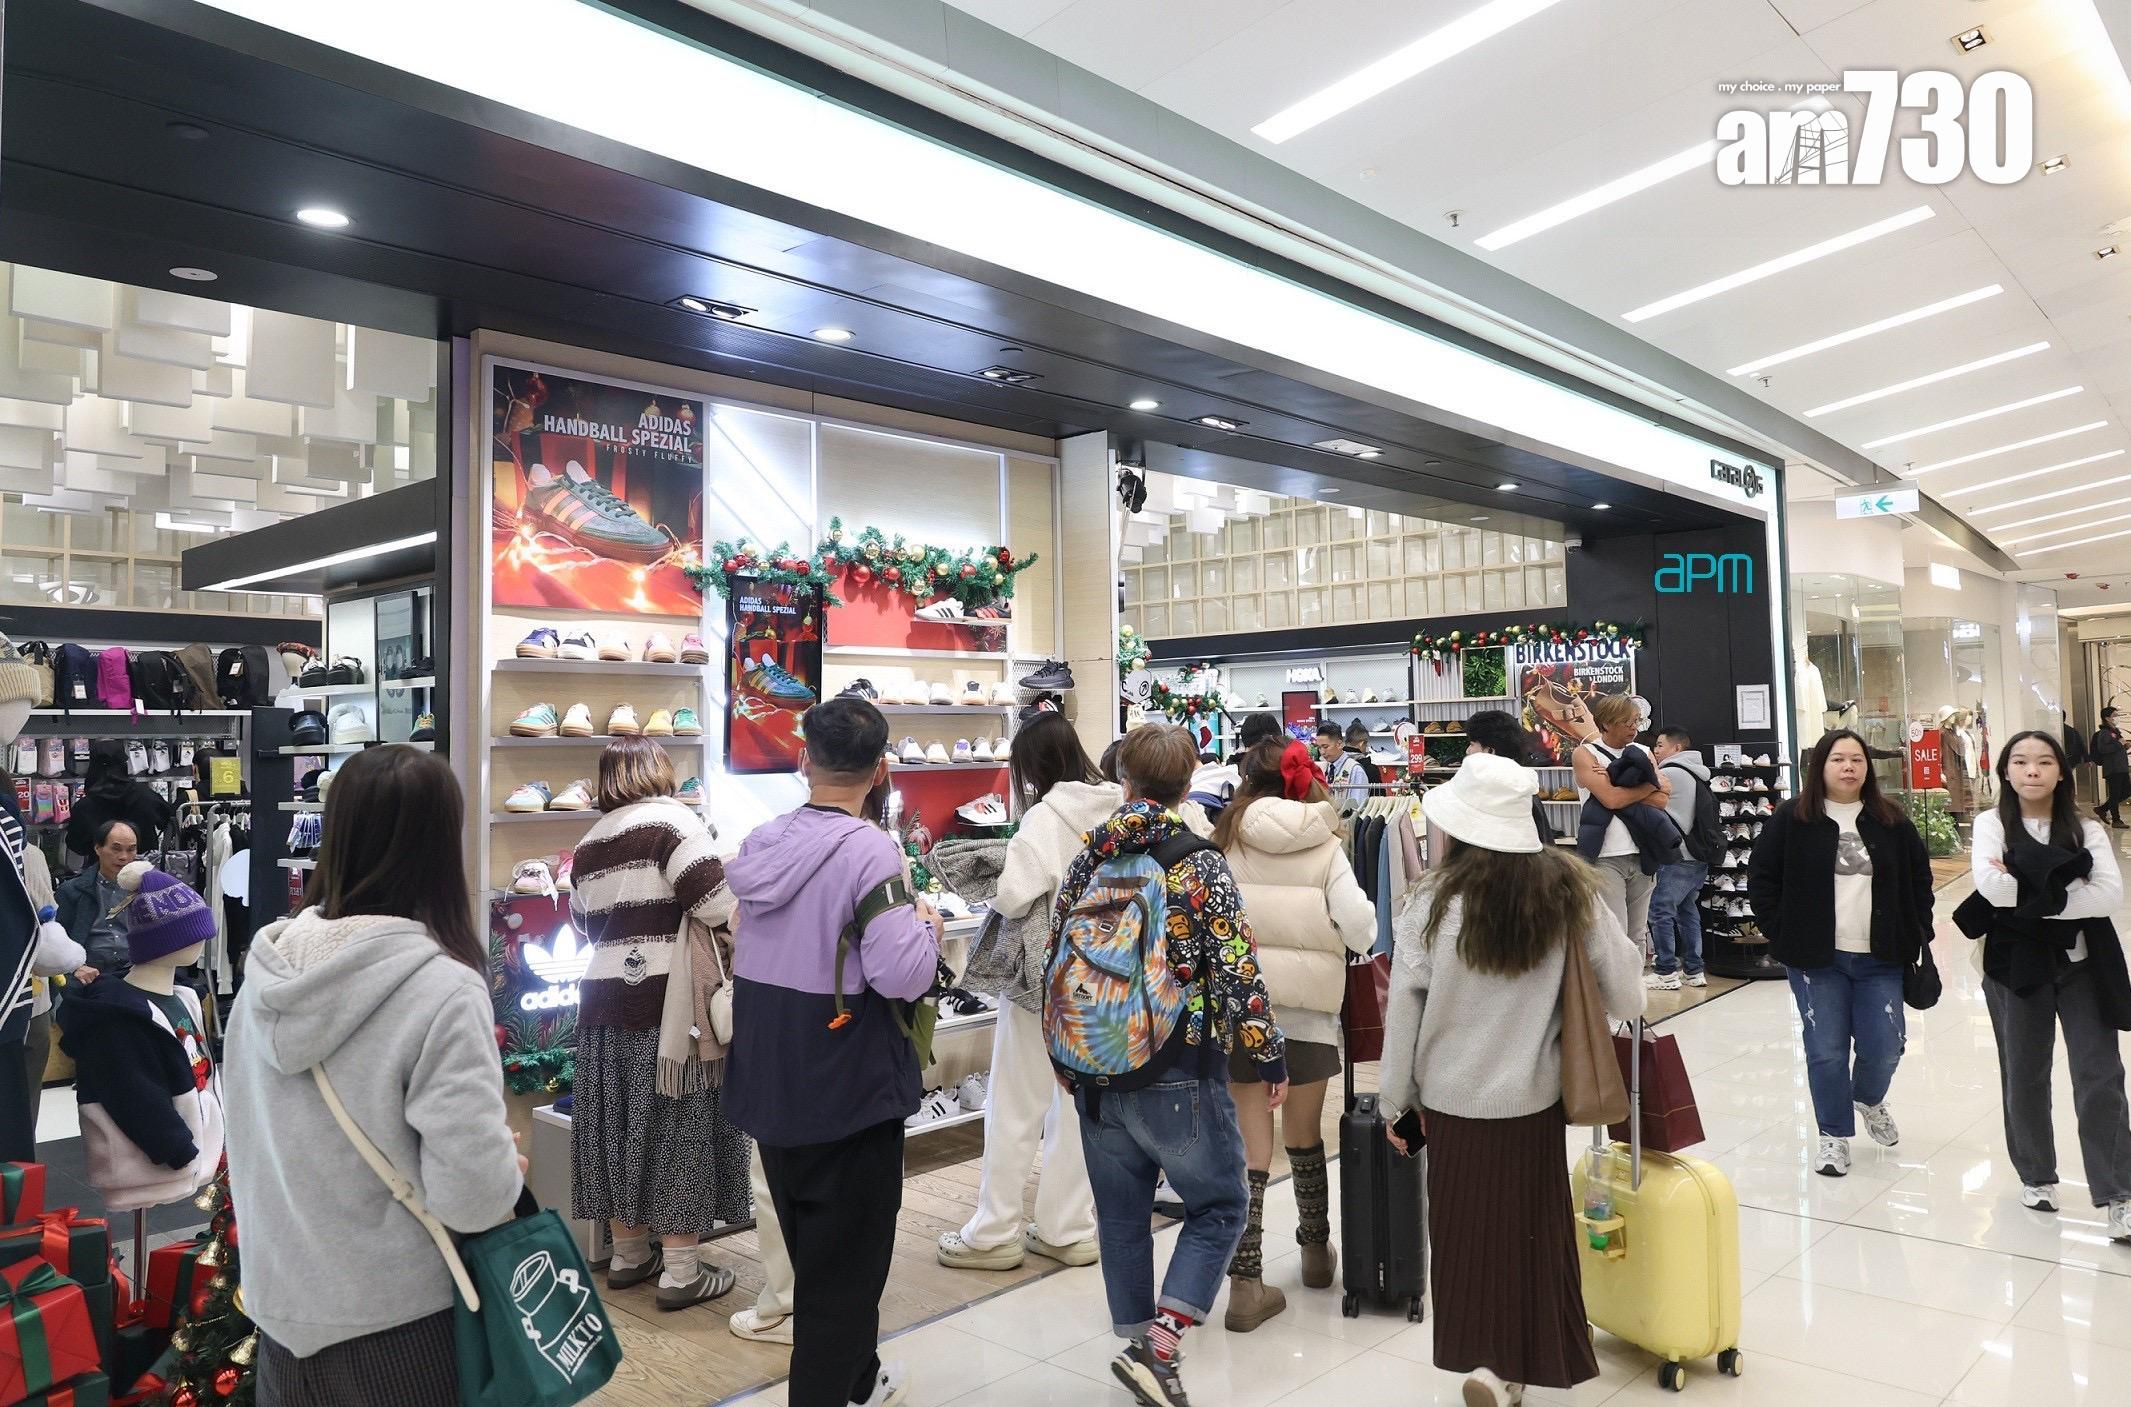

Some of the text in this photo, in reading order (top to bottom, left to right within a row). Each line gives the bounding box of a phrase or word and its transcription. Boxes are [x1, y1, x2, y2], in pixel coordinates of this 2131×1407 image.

[638, 413, 692, 436] ADIDAS
[544, 415, 692, 453] HANDBALL SPEZIAL
[606, 444, 693, 464] FROSTY FLUFFY
[740, 596, 762, 605] ADIDAS
[740, 604, 796, 614] HANDBALL SPEZIAL
[1516, 637, 1631, 664] BIRKENSTOCK
[1574, 665, 1624, 677] BIRKENSTOCK
[1593, 674, 1624, 684] LONDON
[1410, 753, 1423, 764] 299
[1914, 748, 1938, 762] SALE
